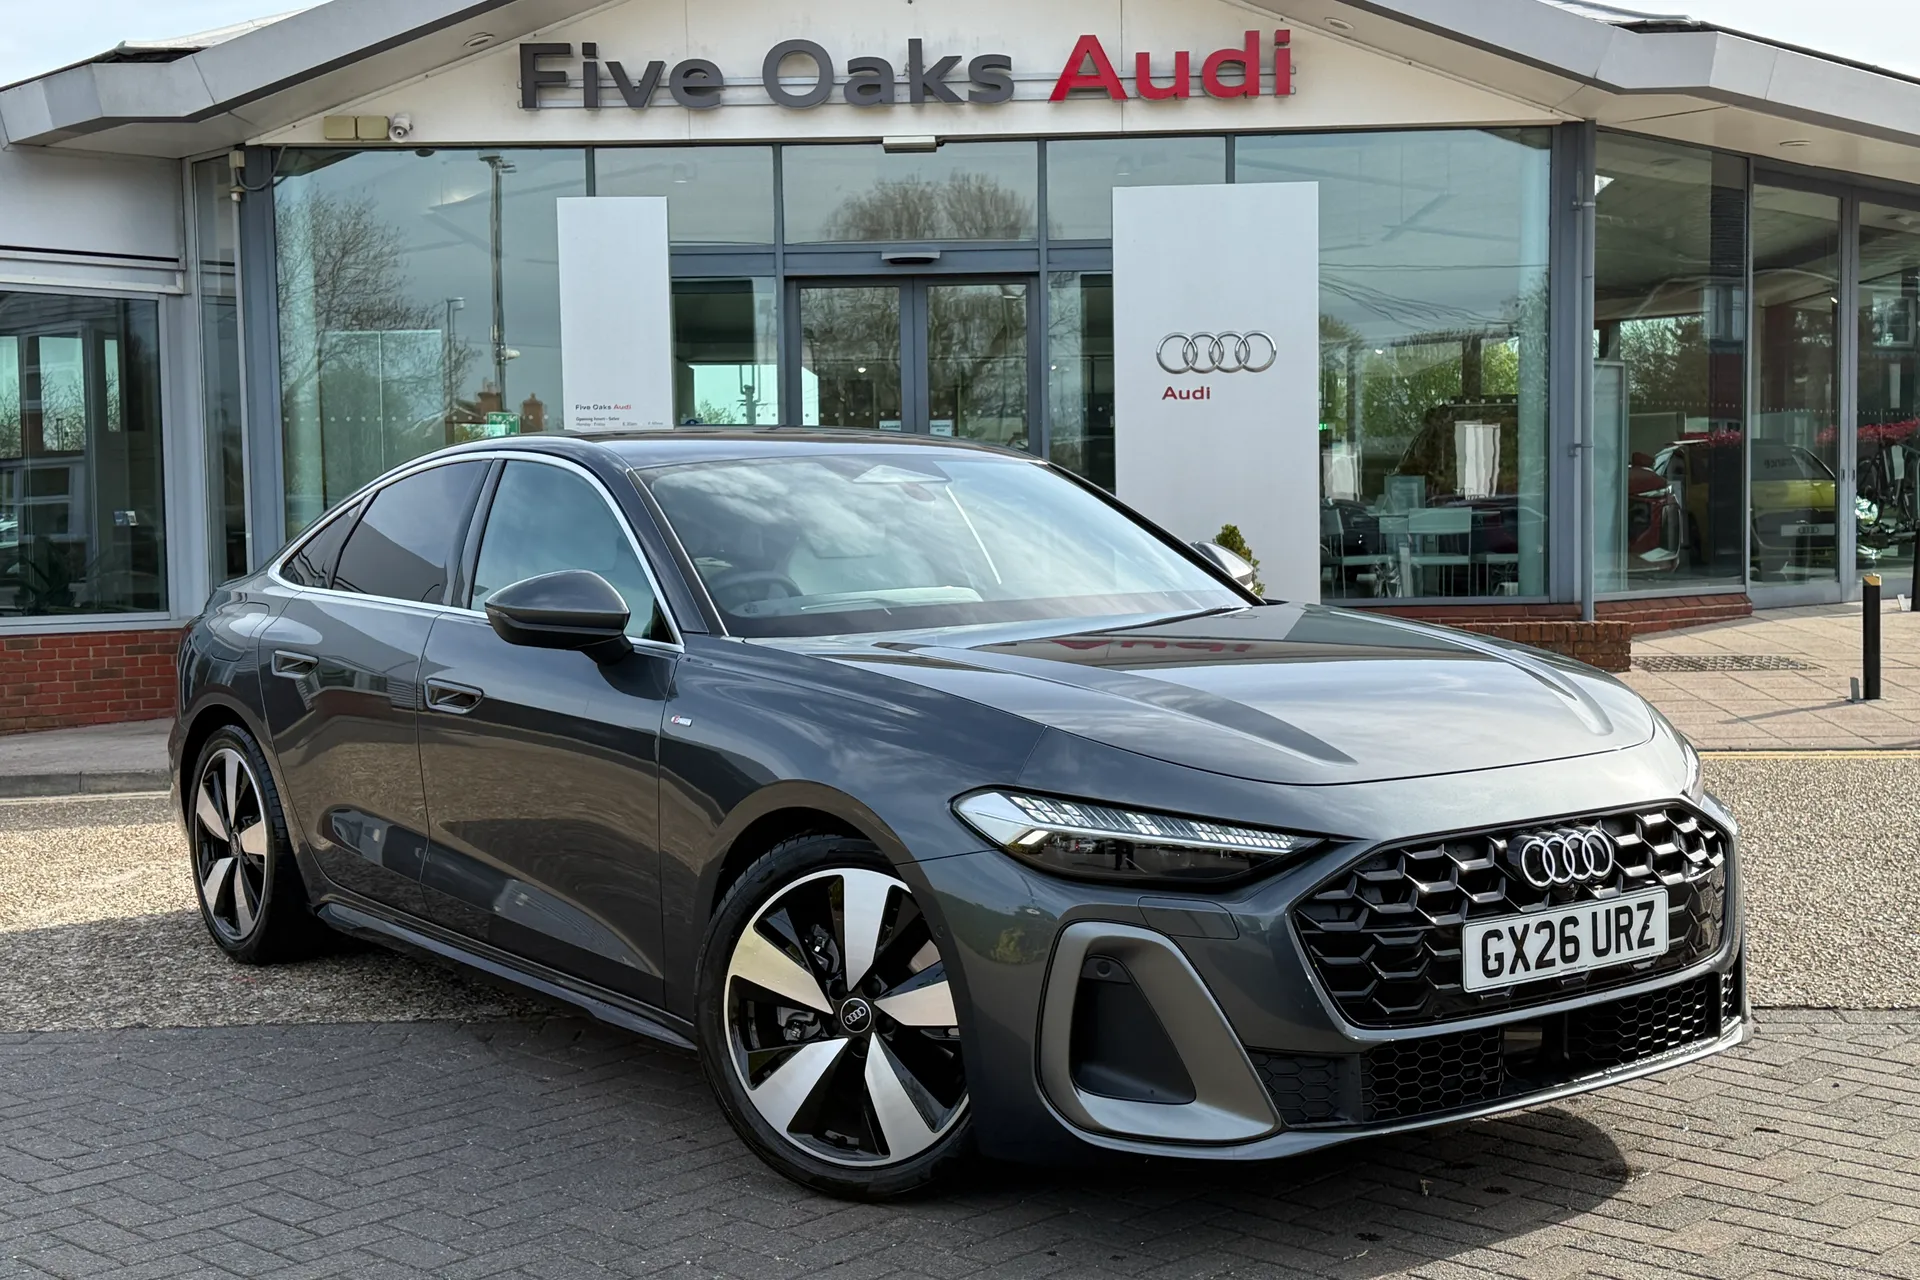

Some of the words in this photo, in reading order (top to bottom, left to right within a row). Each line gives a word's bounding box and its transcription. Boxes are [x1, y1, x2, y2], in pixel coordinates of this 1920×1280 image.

[519, 41, 726, 111] Five
[761, 37, 1015, 109] Oaks
[1048, 29, 1292, 104] Audi
[1161, 386, 1211, 400] Audi
[1481, 915, 1580, 978] GX26
[1591, 900, 1656, 958] URZ
